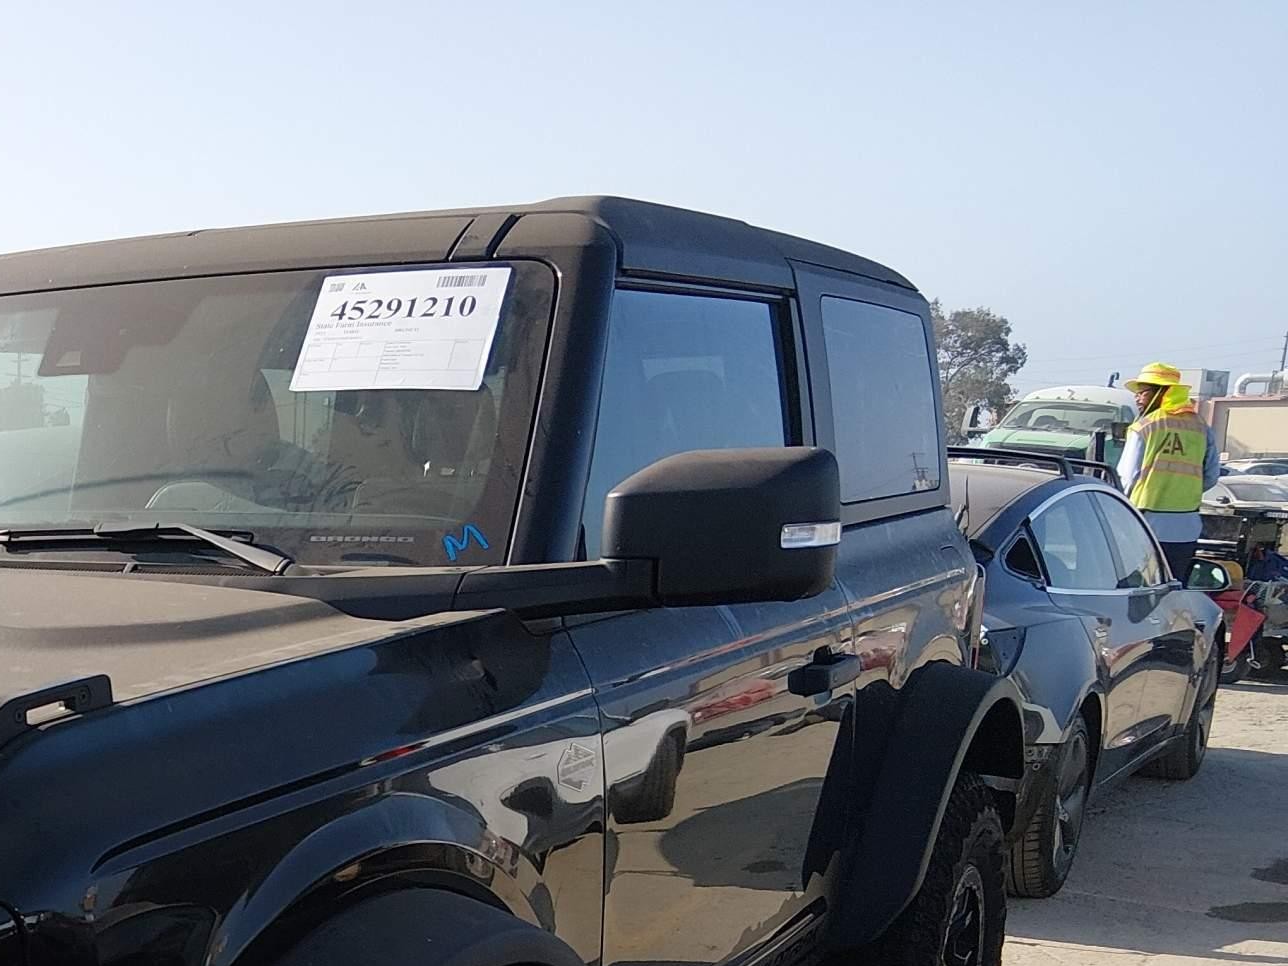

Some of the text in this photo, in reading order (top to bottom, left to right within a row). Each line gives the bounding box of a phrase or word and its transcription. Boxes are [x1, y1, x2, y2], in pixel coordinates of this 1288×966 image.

[330, 295, 477, 321] 45291210
[310, 535, 414, 543] BRONCO
[441, 523, 489, 561] M
